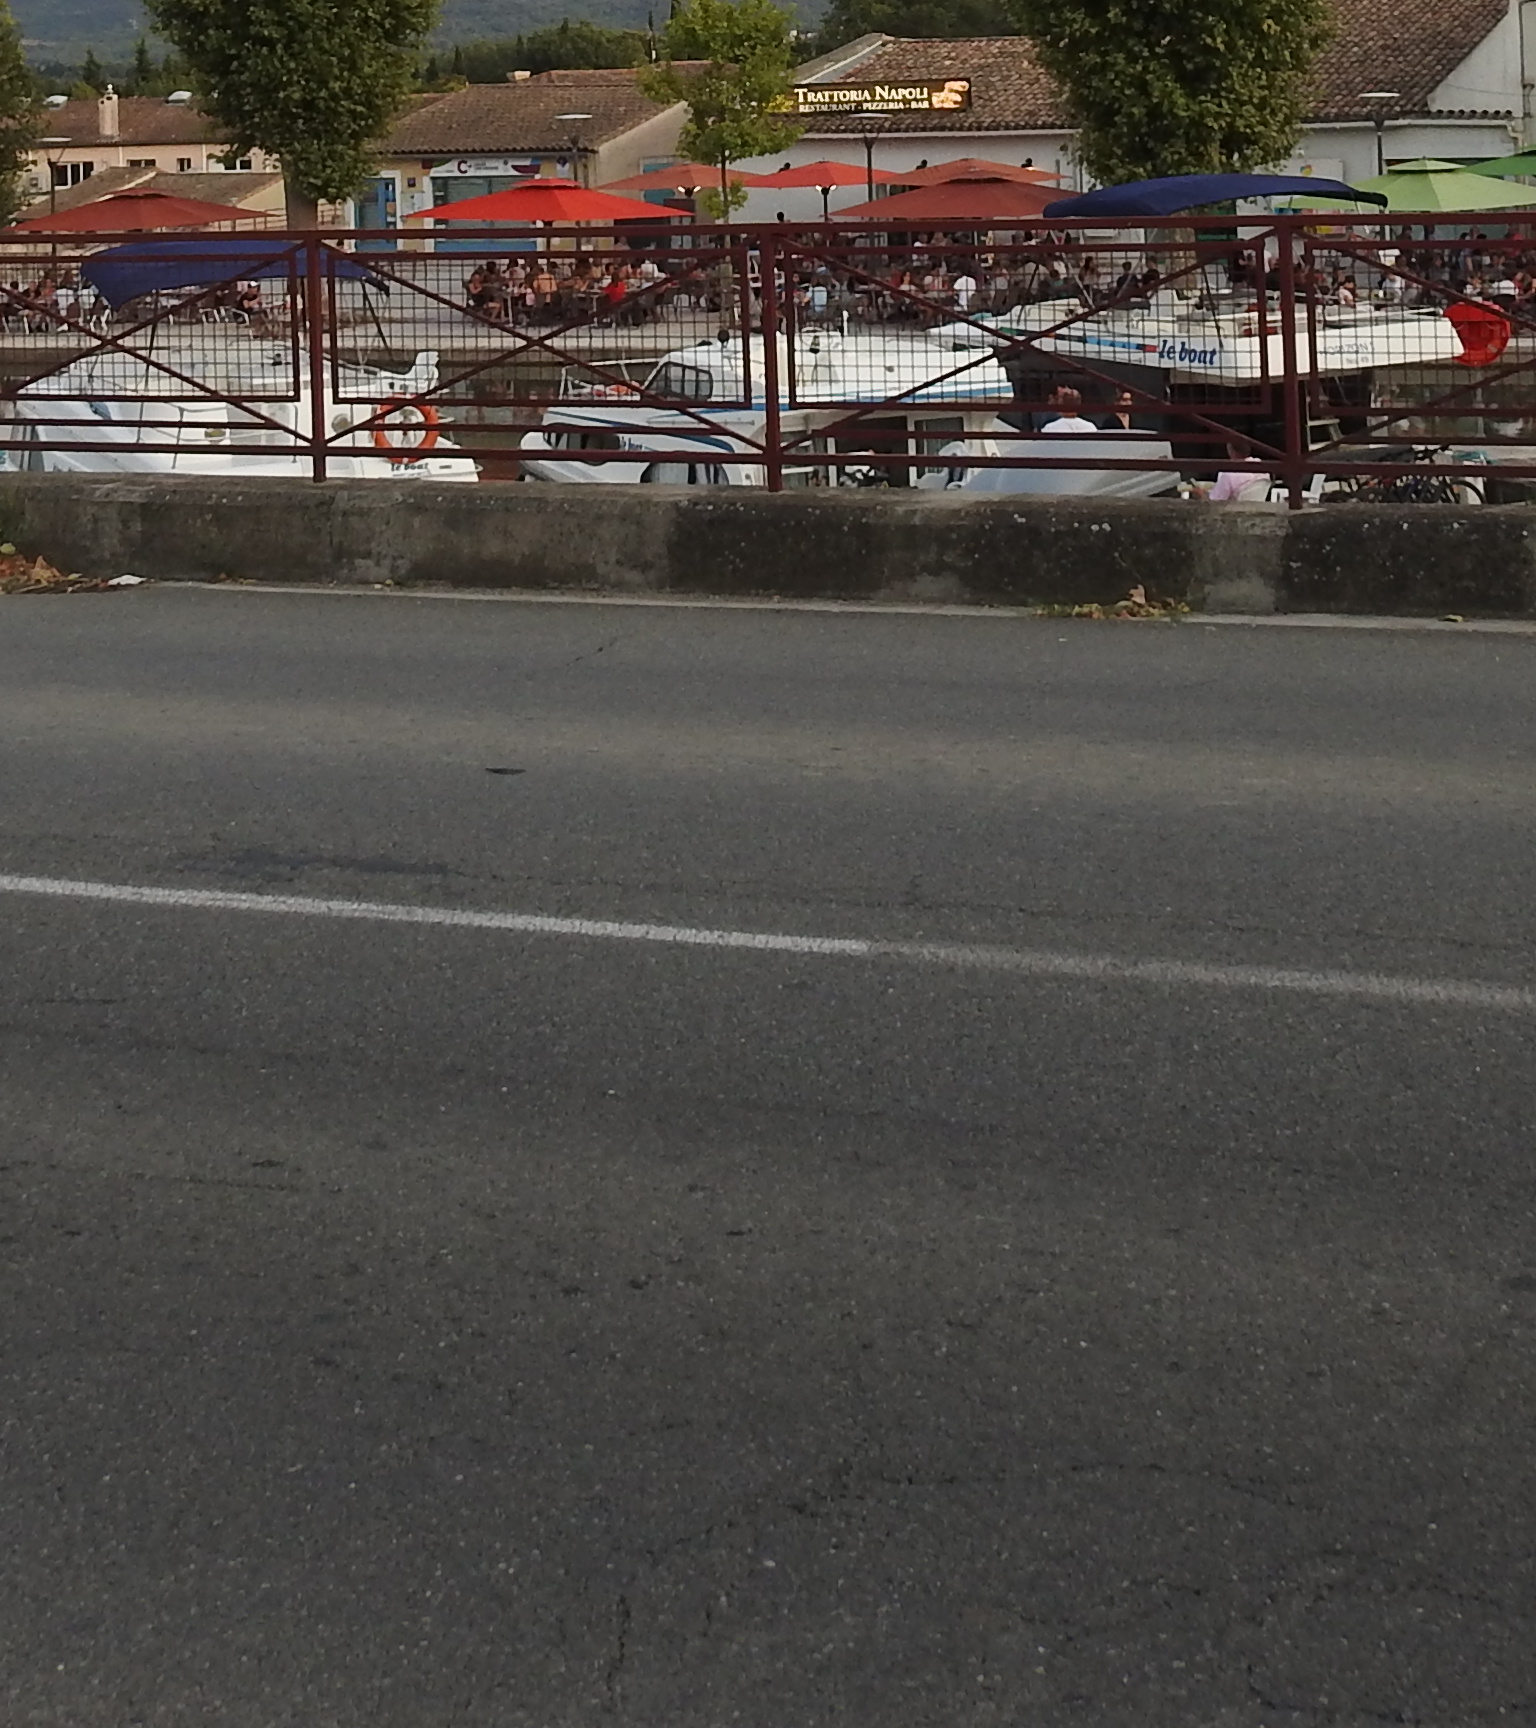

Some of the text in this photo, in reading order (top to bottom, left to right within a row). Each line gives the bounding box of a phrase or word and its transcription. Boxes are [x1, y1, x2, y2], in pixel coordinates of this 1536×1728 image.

[794, 85, 928, 103] TRATTORIA NAPOLI
[799, 101, 930, 113] RESTAURANT PIZZERIA BAR
[1159, 340, 1218, 365] le boat
